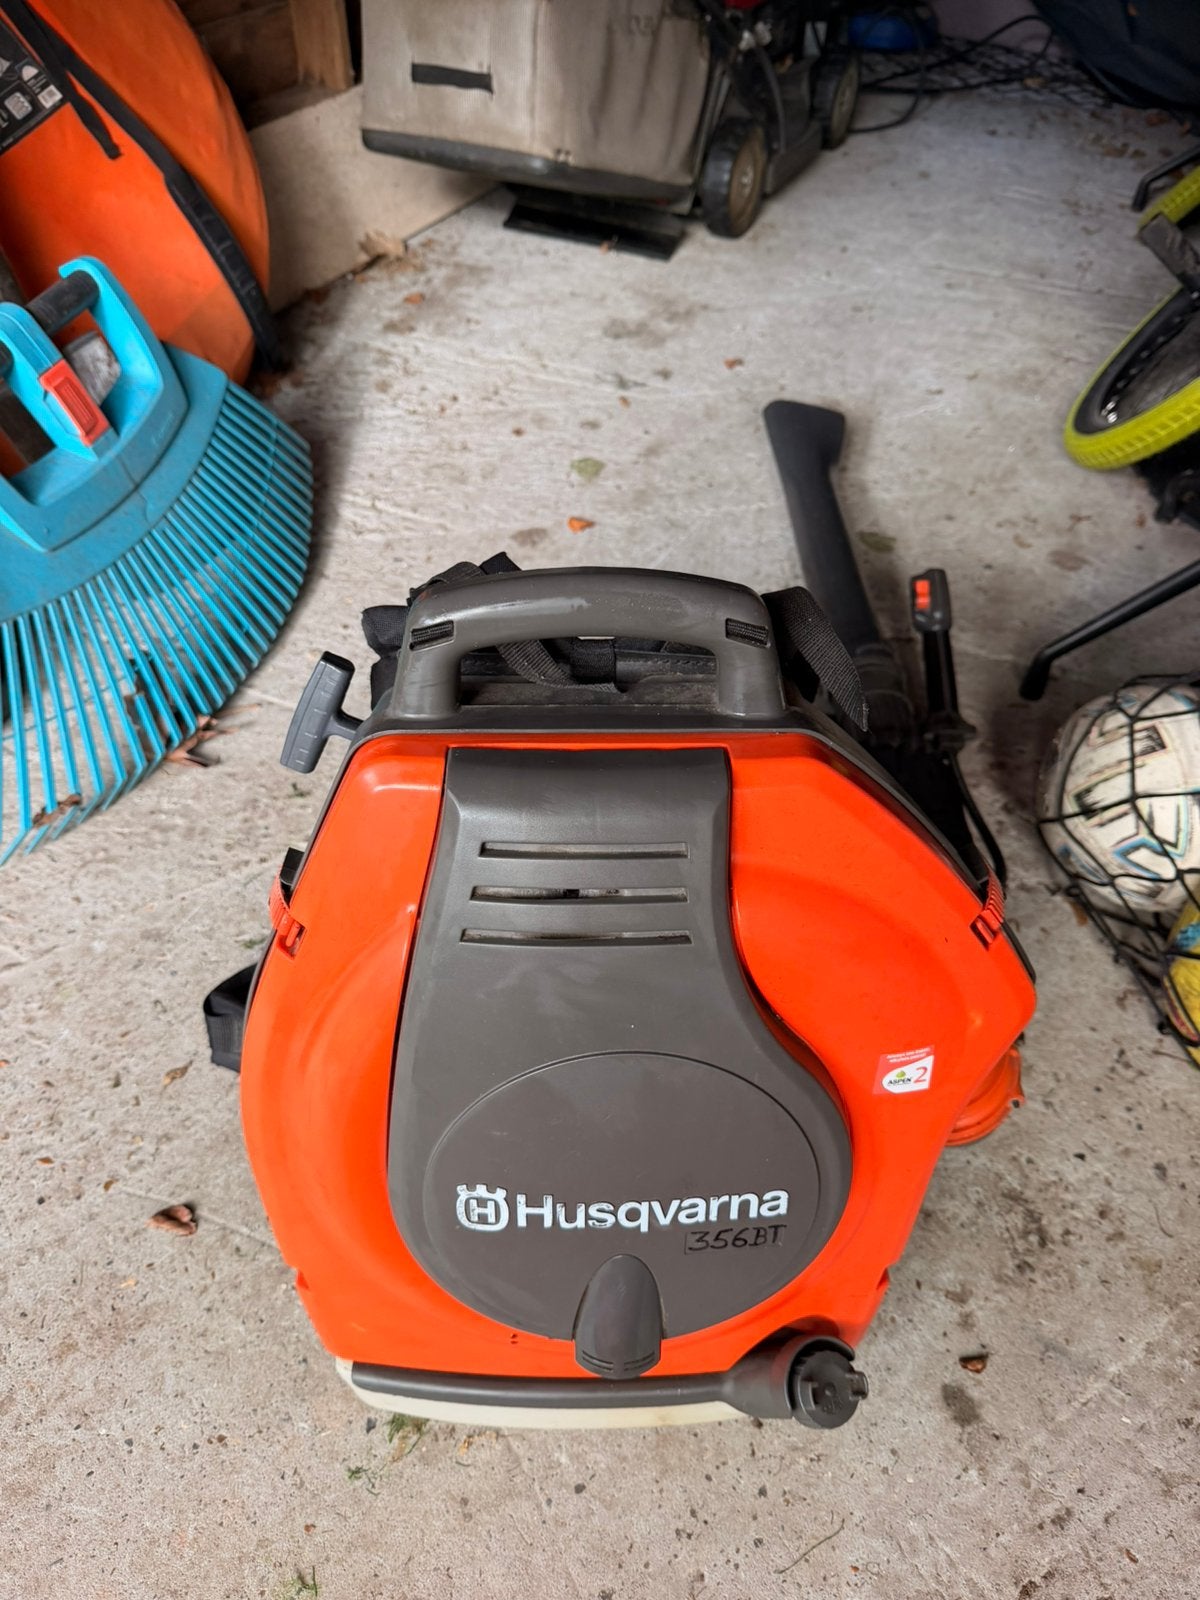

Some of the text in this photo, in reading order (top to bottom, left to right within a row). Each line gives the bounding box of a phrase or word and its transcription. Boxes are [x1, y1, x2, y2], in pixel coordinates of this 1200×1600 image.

[888, 1066, 928, 1085] ASPEN 2
[516, 1189, 789, 1233] Husqvarna
[687, 1224, 787, 1252] 356BT
